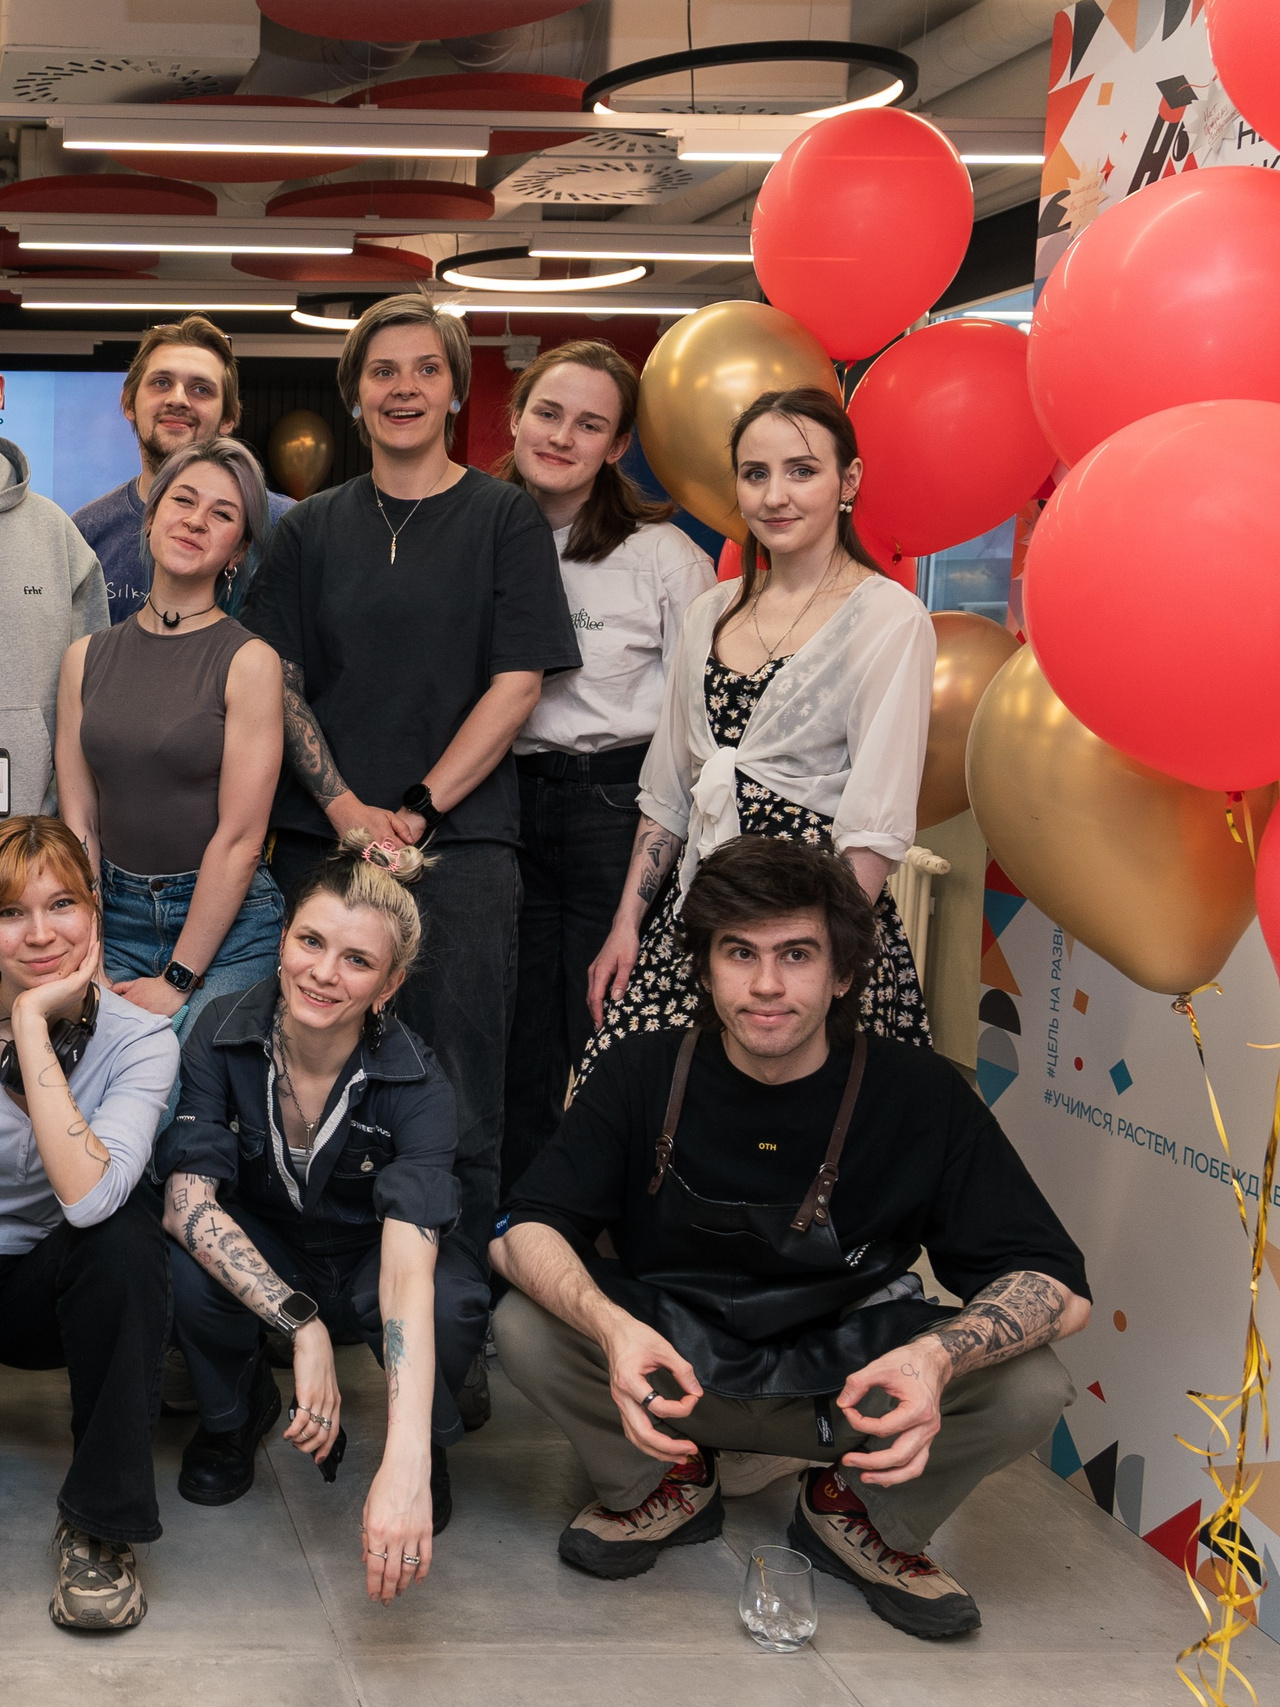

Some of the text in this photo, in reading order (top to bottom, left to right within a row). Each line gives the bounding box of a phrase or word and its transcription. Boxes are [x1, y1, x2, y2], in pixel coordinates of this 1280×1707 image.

[106, 582, 151, 603] Silky
[1049, 987, 1060, 1012] НА
[1046, 1016, 1059, 1078] #ЦЕЛЬ
[1044, 1088, 1114, 1136] #УЧИМСЯ,
[1118, 1118, 1178, 1165] РАСТЕМ,
[758, 1142, 777, 1151] OTH
